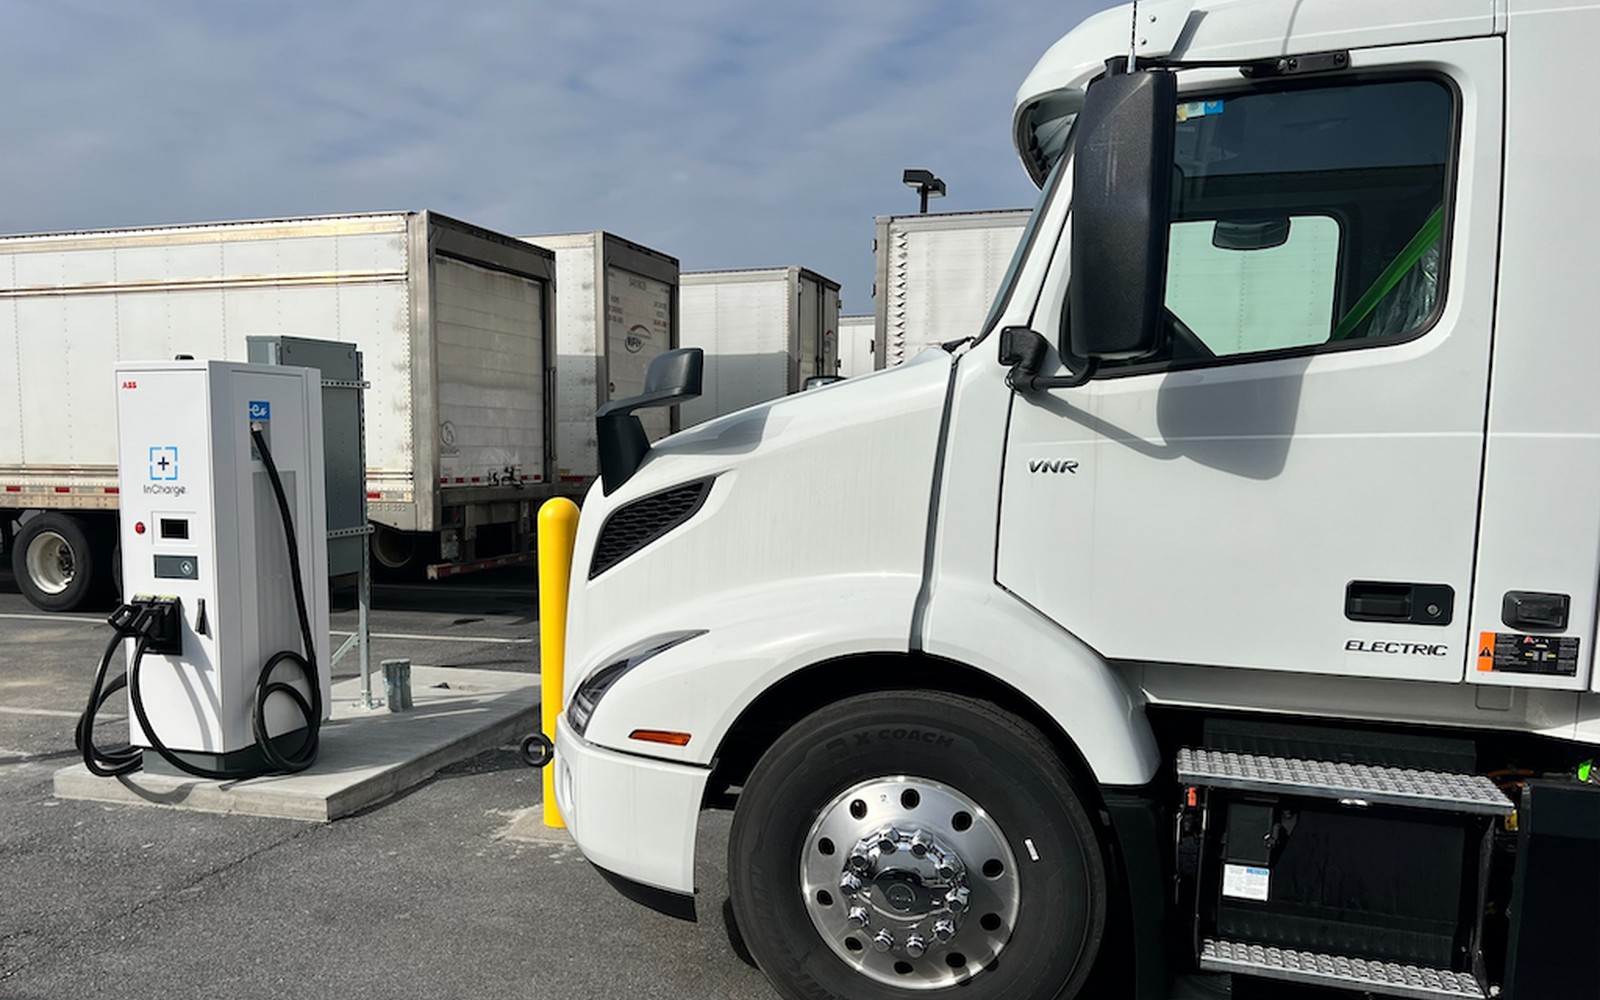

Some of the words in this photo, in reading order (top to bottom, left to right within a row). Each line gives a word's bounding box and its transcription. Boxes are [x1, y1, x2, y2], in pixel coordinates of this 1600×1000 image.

[1029, 460, 1079, 474] VNR
[143, 484, 186, 497] InCharge
[1344, 640, 1448, 656] ELECTRIC
[877, 728, 954, 749] COACH
